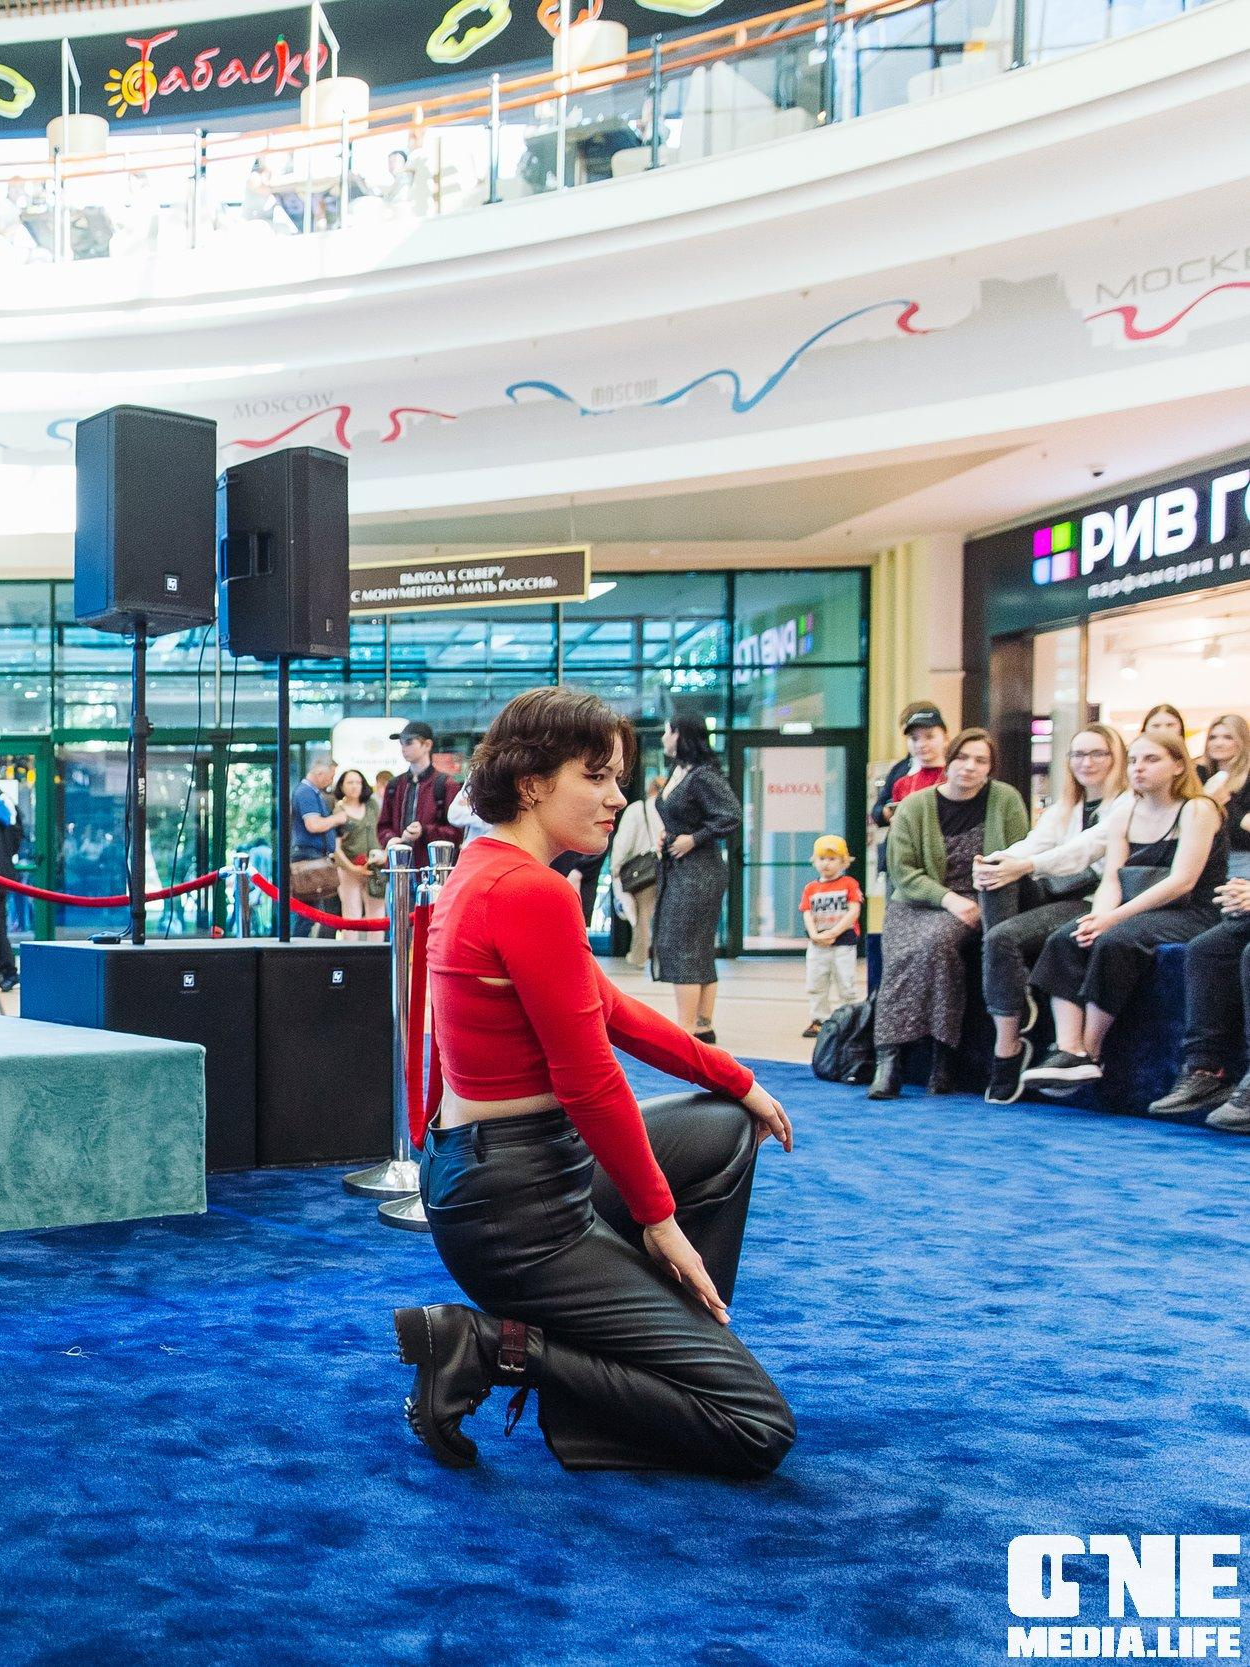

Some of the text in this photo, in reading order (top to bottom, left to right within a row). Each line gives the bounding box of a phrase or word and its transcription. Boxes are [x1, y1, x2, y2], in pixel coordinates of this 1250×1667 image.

[125, 29, 328, 115] Табаско
[233, 392, 335, 419] MOSCOW
[1080, 469, 1250, 576] РИВ Г
[350, 575, 559, 602] С МОНУМЕНТОМ «МАТЬ РОССИЯ»
[400, 566, 506, 586] ВЫХОД К СКВЕРУ
[767, 782, 823, 797] ВЫХОД
